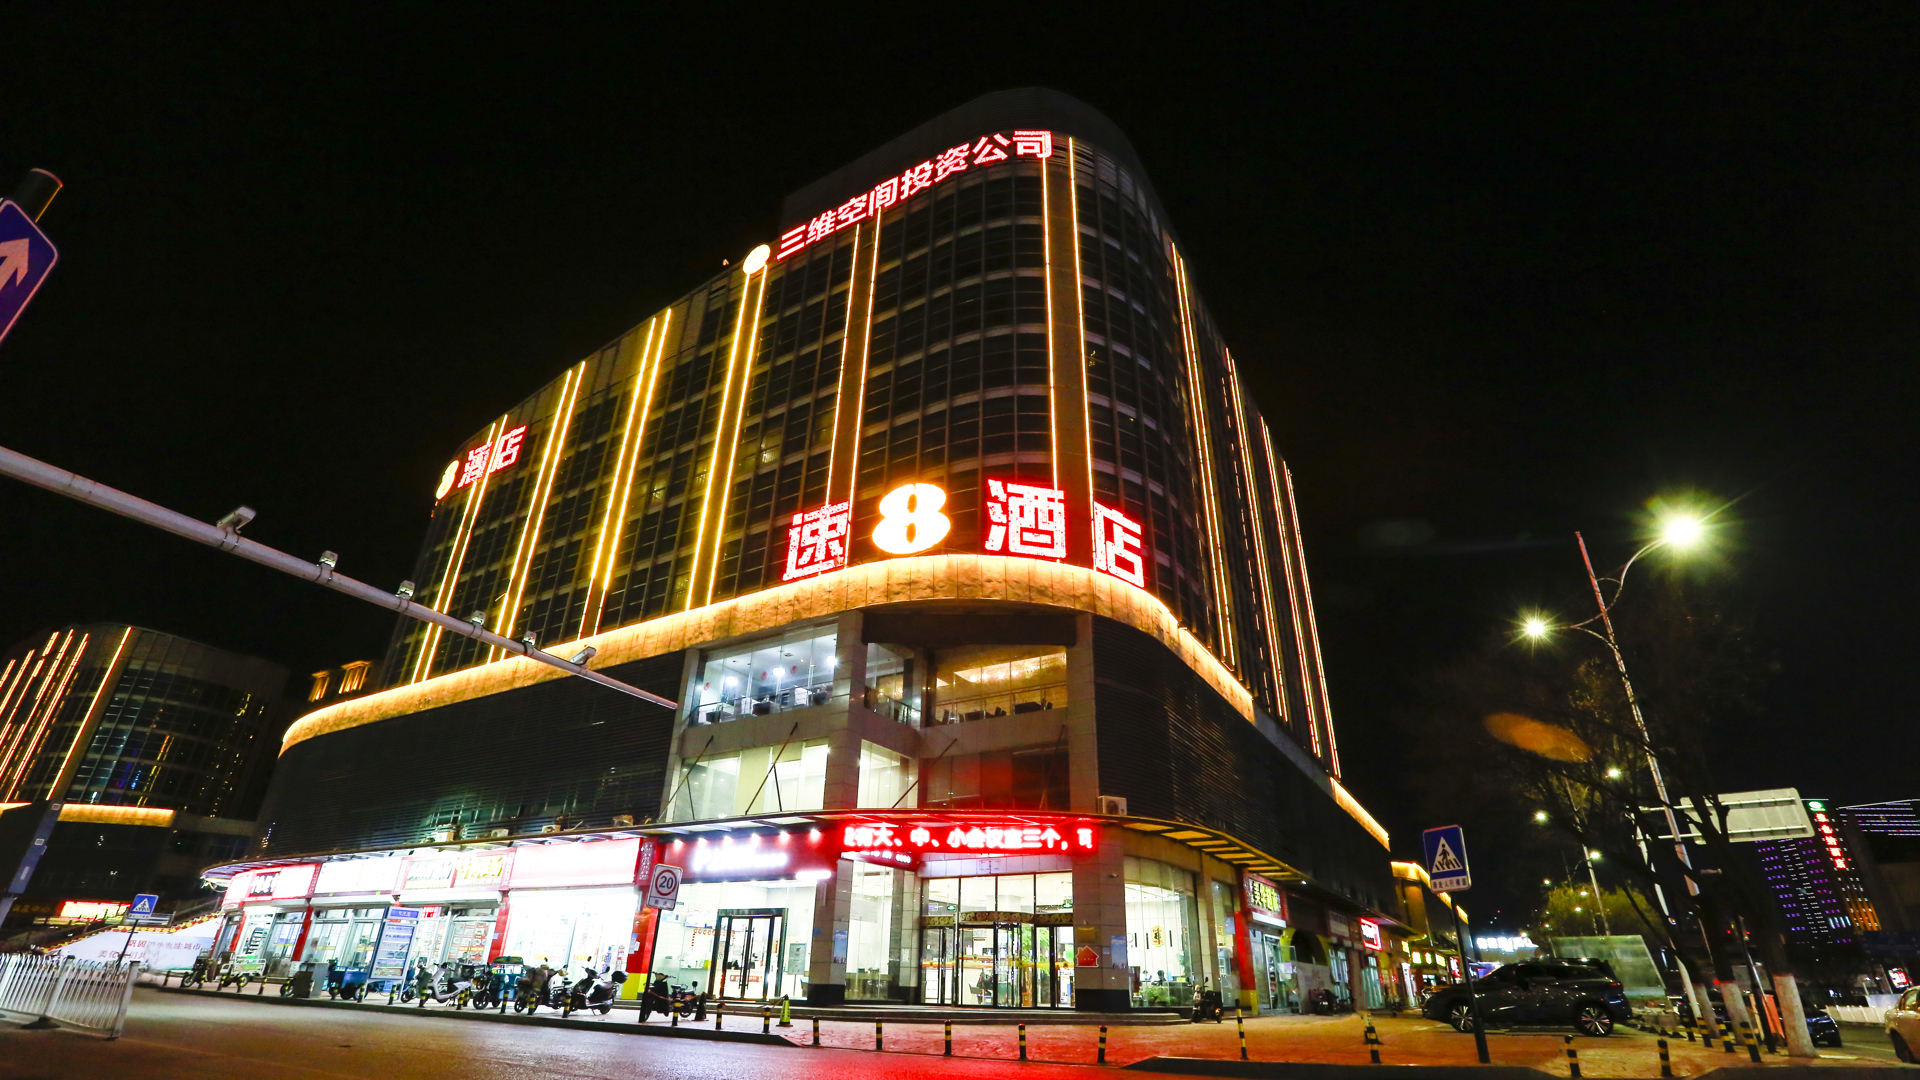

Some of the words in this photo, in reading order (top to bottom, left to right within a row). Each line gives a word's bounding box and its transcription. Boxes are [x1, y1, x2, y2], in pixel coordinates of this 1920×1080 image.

[776, 130, 1053, 261] 三维空间投资公司
[782, 478, 1145, 588] 速8酒店
[659, 875, 674, 890] 20
